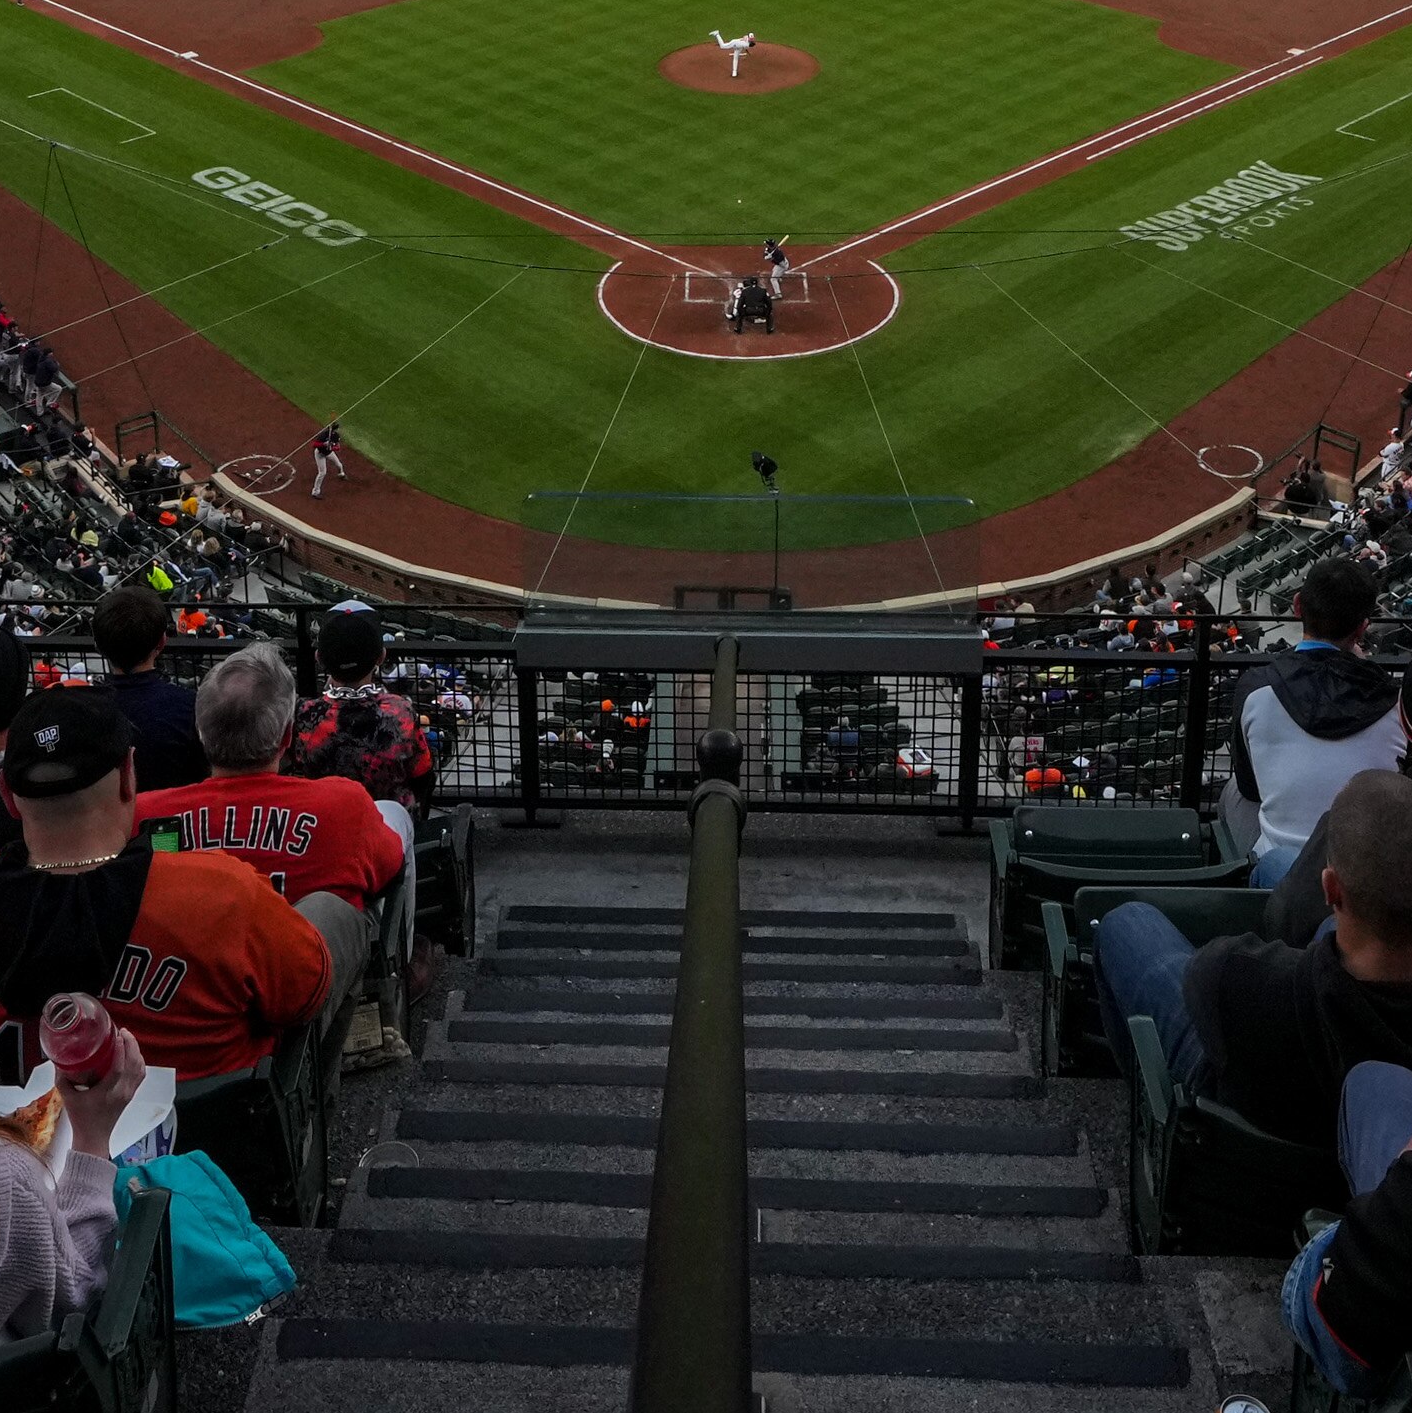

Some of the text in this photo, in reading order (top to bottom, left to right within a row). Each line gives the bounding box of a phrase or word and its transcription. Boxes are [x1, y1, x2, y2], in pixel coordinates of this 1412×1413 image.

[190, 166, 367, 247] GEICO
[1119, 159, 1323, 251] SUPERBOOK
[1220, 196, 1314, 239] SPORTS
[37, 727, 58, 744] DAP
